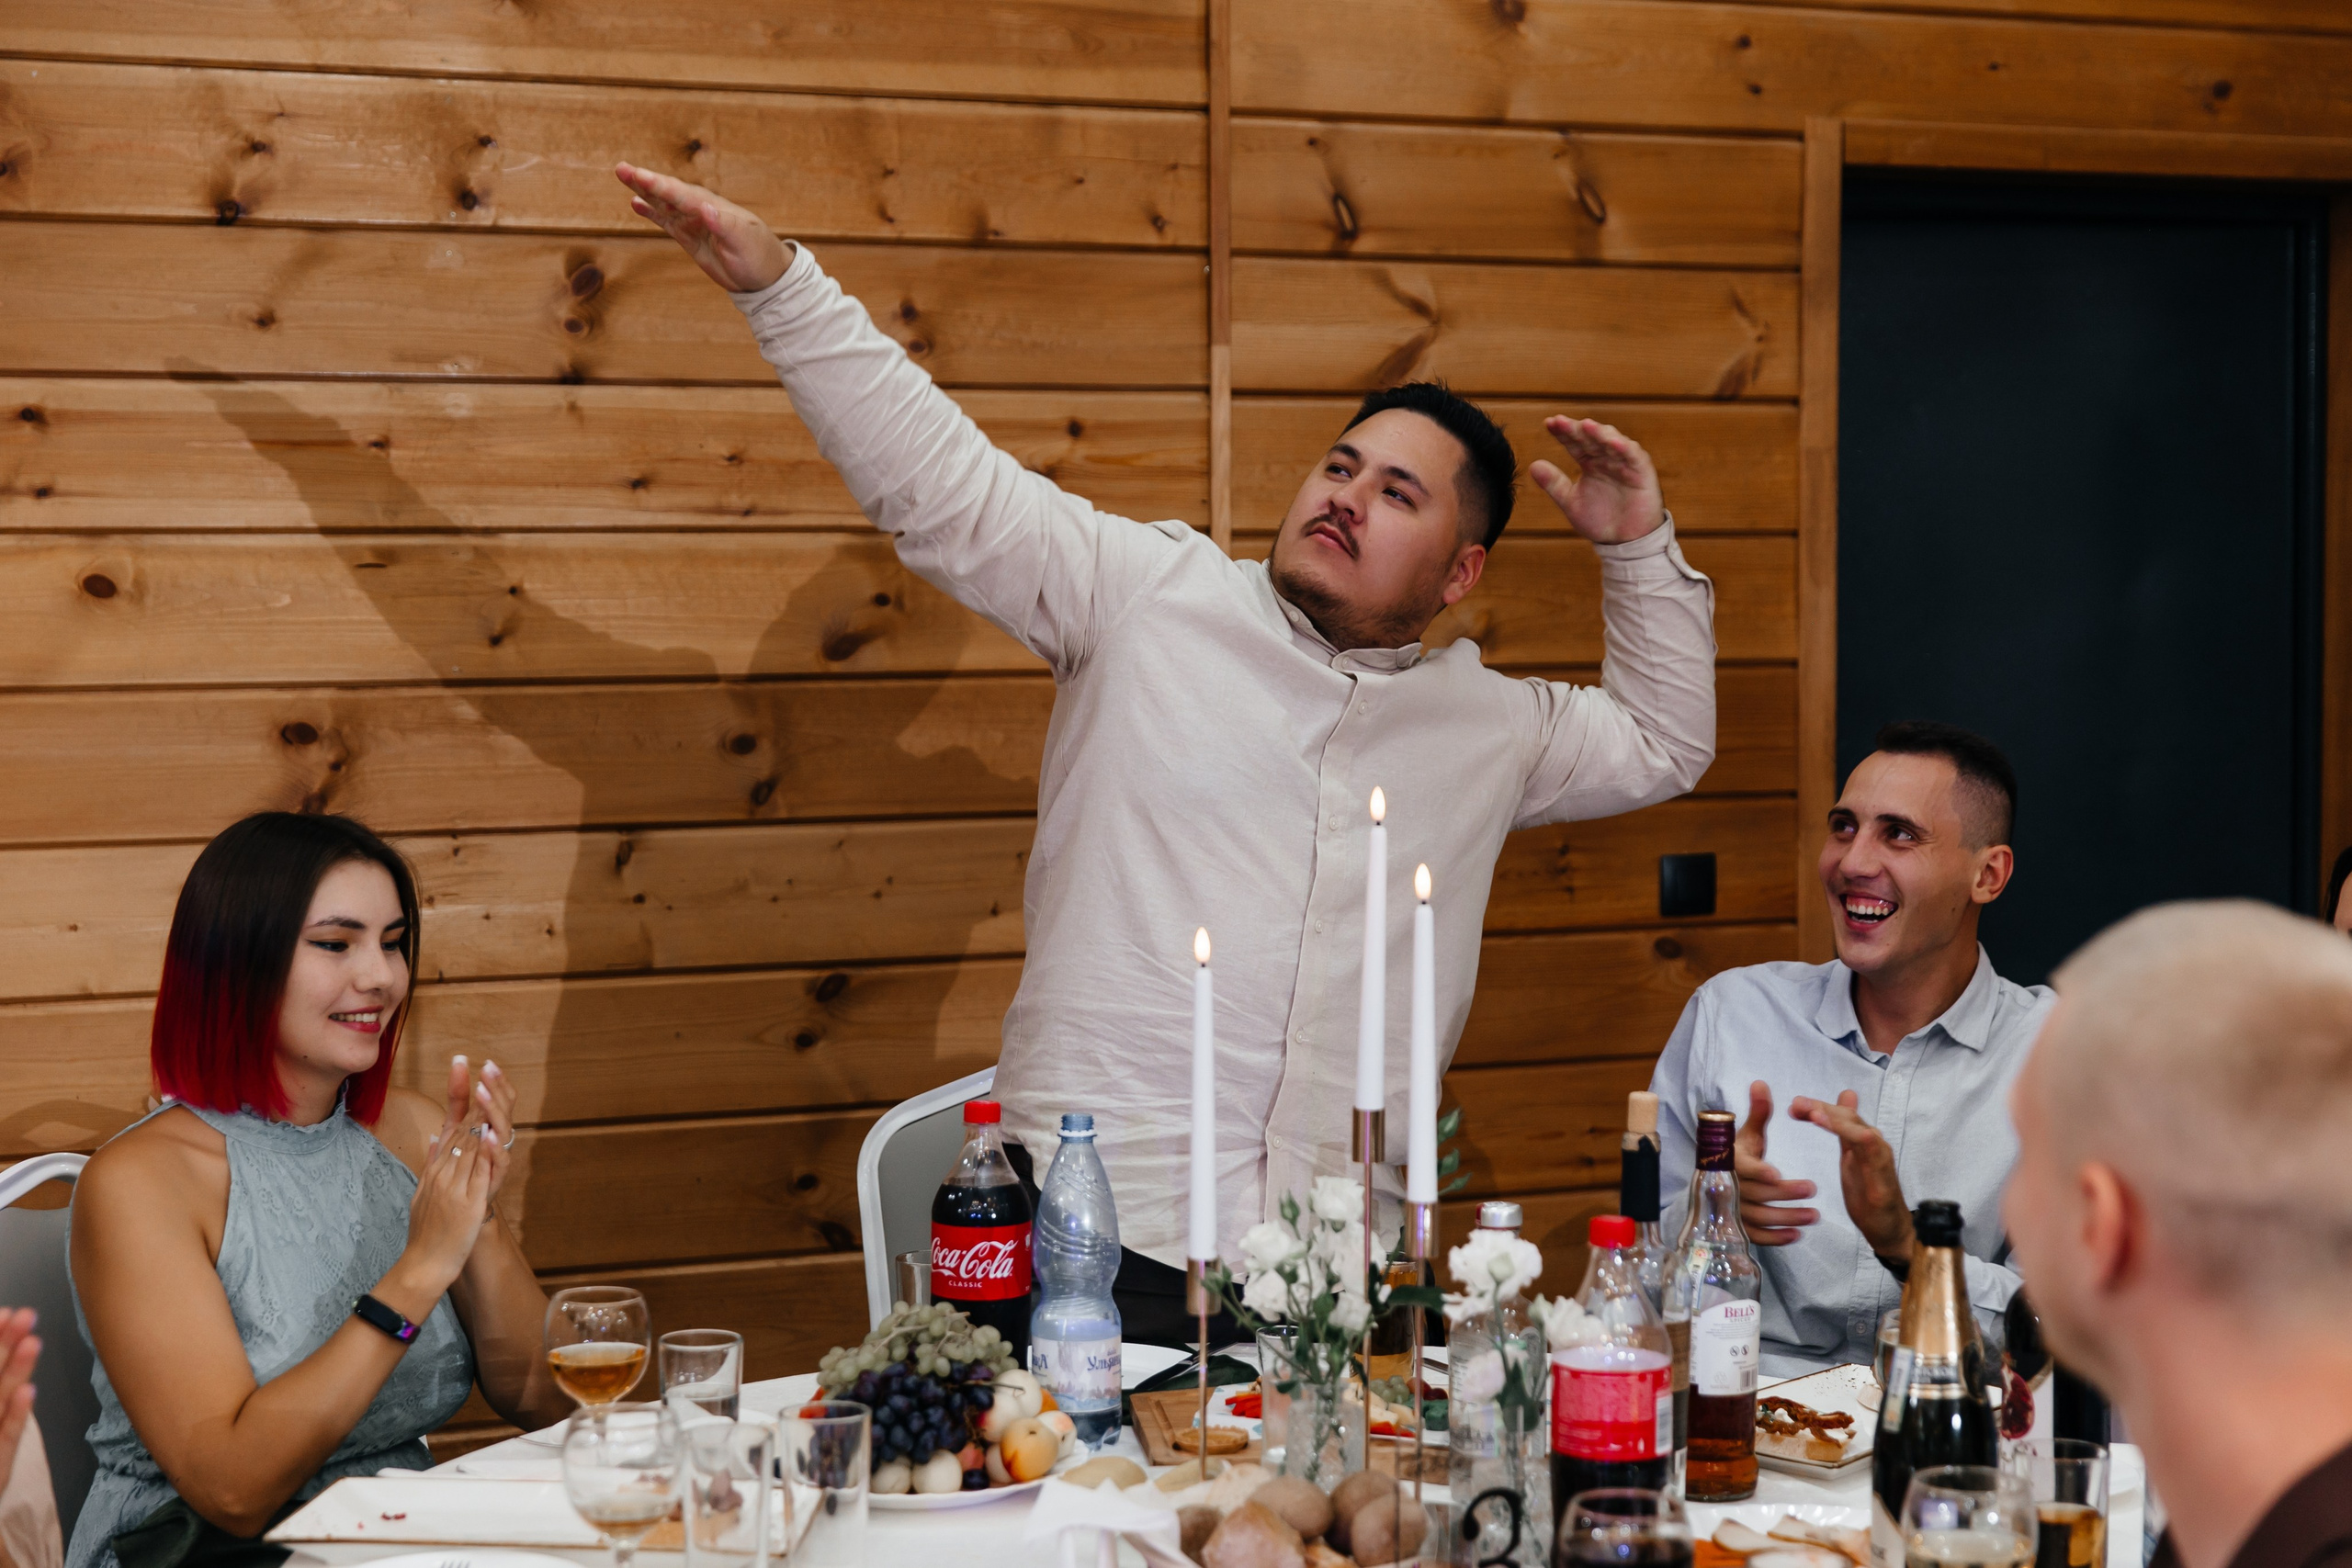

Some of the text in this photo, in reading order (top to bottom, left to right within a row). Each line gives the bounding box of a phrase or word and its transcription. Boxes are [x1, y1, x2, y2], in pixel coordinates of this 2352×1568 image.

[931, 1236, 1019, 1280] Coca-Cola
[948, 1280, 983, 1288] CLASSIC
[1724, 1304, 1755, 1318] BELL'S
